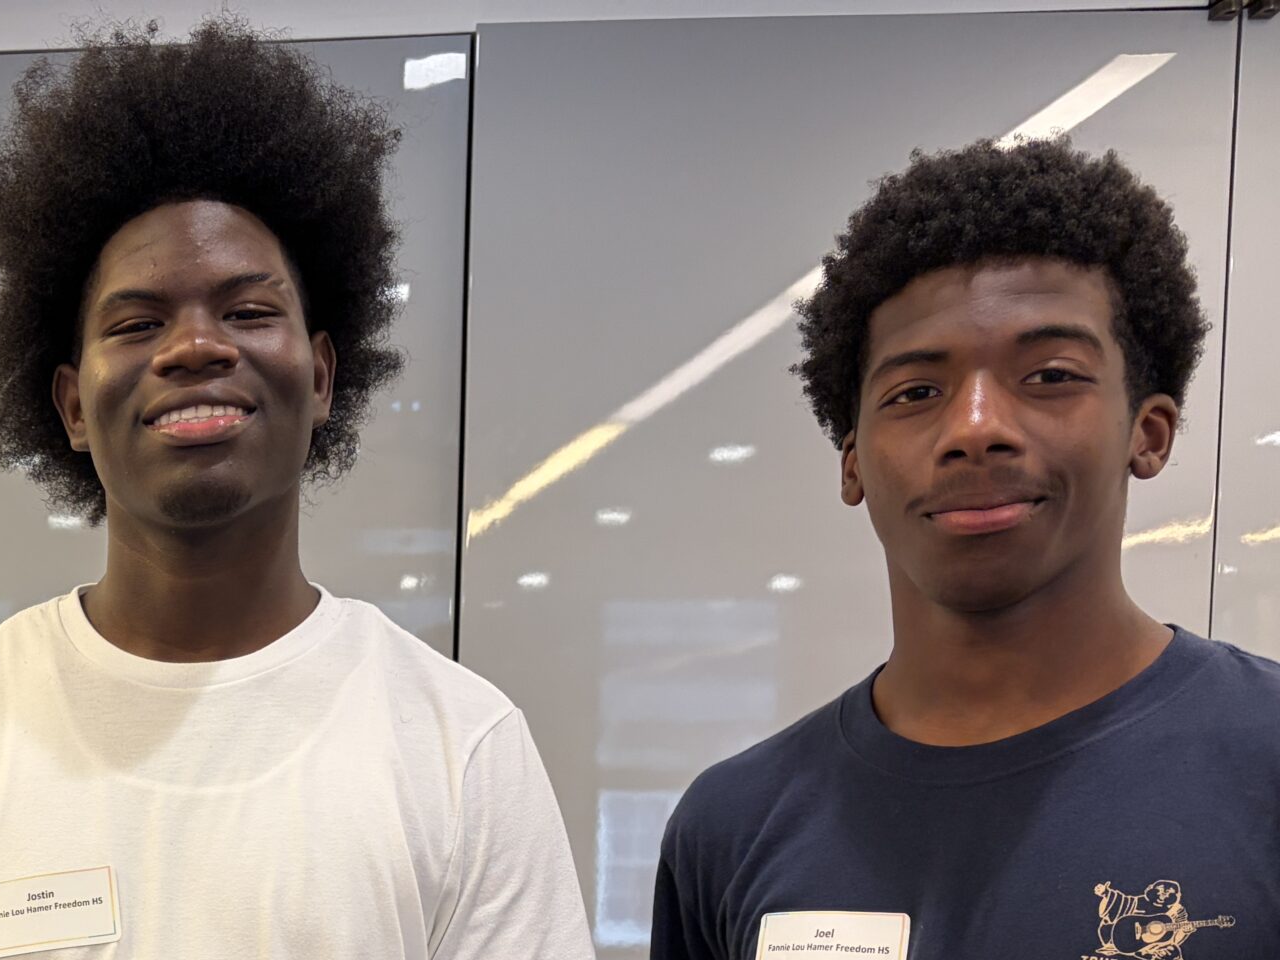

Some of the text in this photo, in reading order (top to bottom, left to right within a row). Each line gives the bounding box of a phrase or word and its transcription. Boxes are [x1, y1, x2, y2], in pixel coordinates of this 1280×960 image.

[26, 890, 55, 902] Jostin
[11, 906, 25, 917] Lou
[26, 903, 53, 914] Hamer
[54, 899, 91, 911] Freedom
[91, 896, 104, 906] HS
[814, 928, 835, 939] Joel
[767, 943, 891, 955] Fannie Lou Hamer Freedom HS
